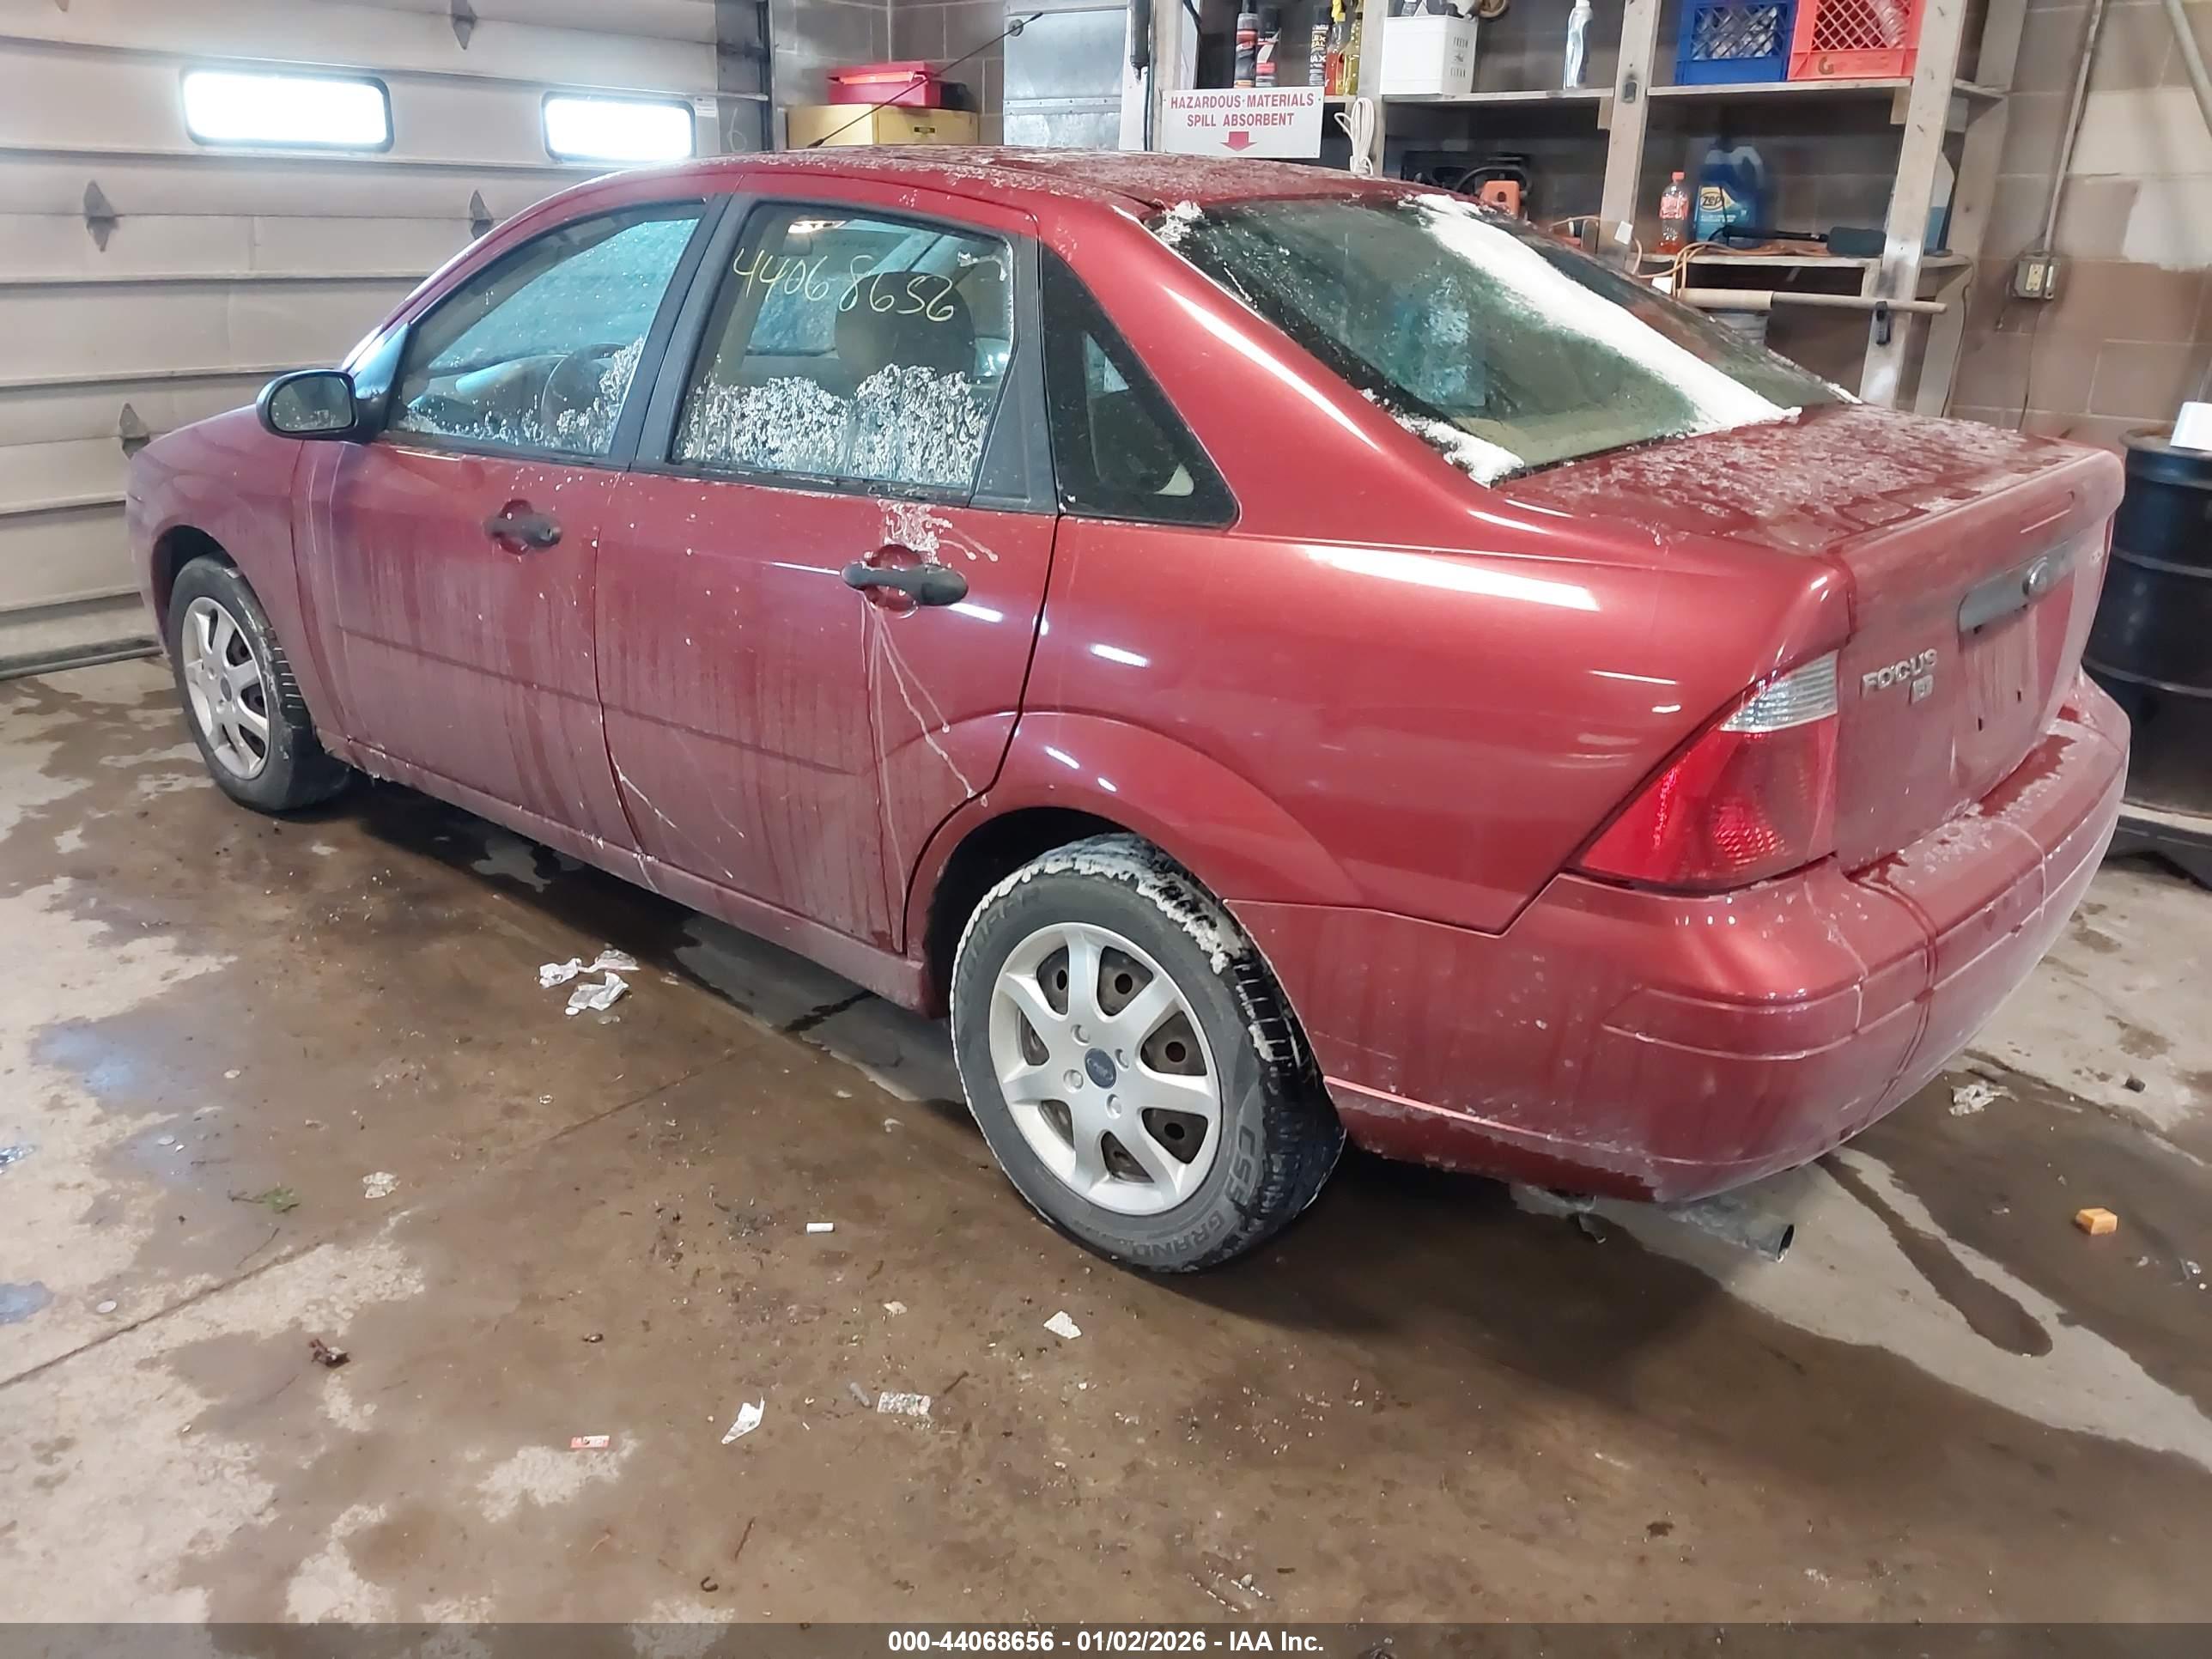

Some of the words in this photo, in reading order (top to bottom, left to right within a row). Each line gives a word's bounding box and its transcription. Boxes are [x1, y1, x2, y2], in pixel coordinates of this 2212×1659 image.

[1170, 95, 1241, 109] HAZARDOUS
[1247, 93, 1314, 107] MATERIALS
[1187, 114, 1216, 127] SPILL
[1223, 112, 1294, 126] ABSORBENT
[1862, 647, 1938, 700] FOCUS
